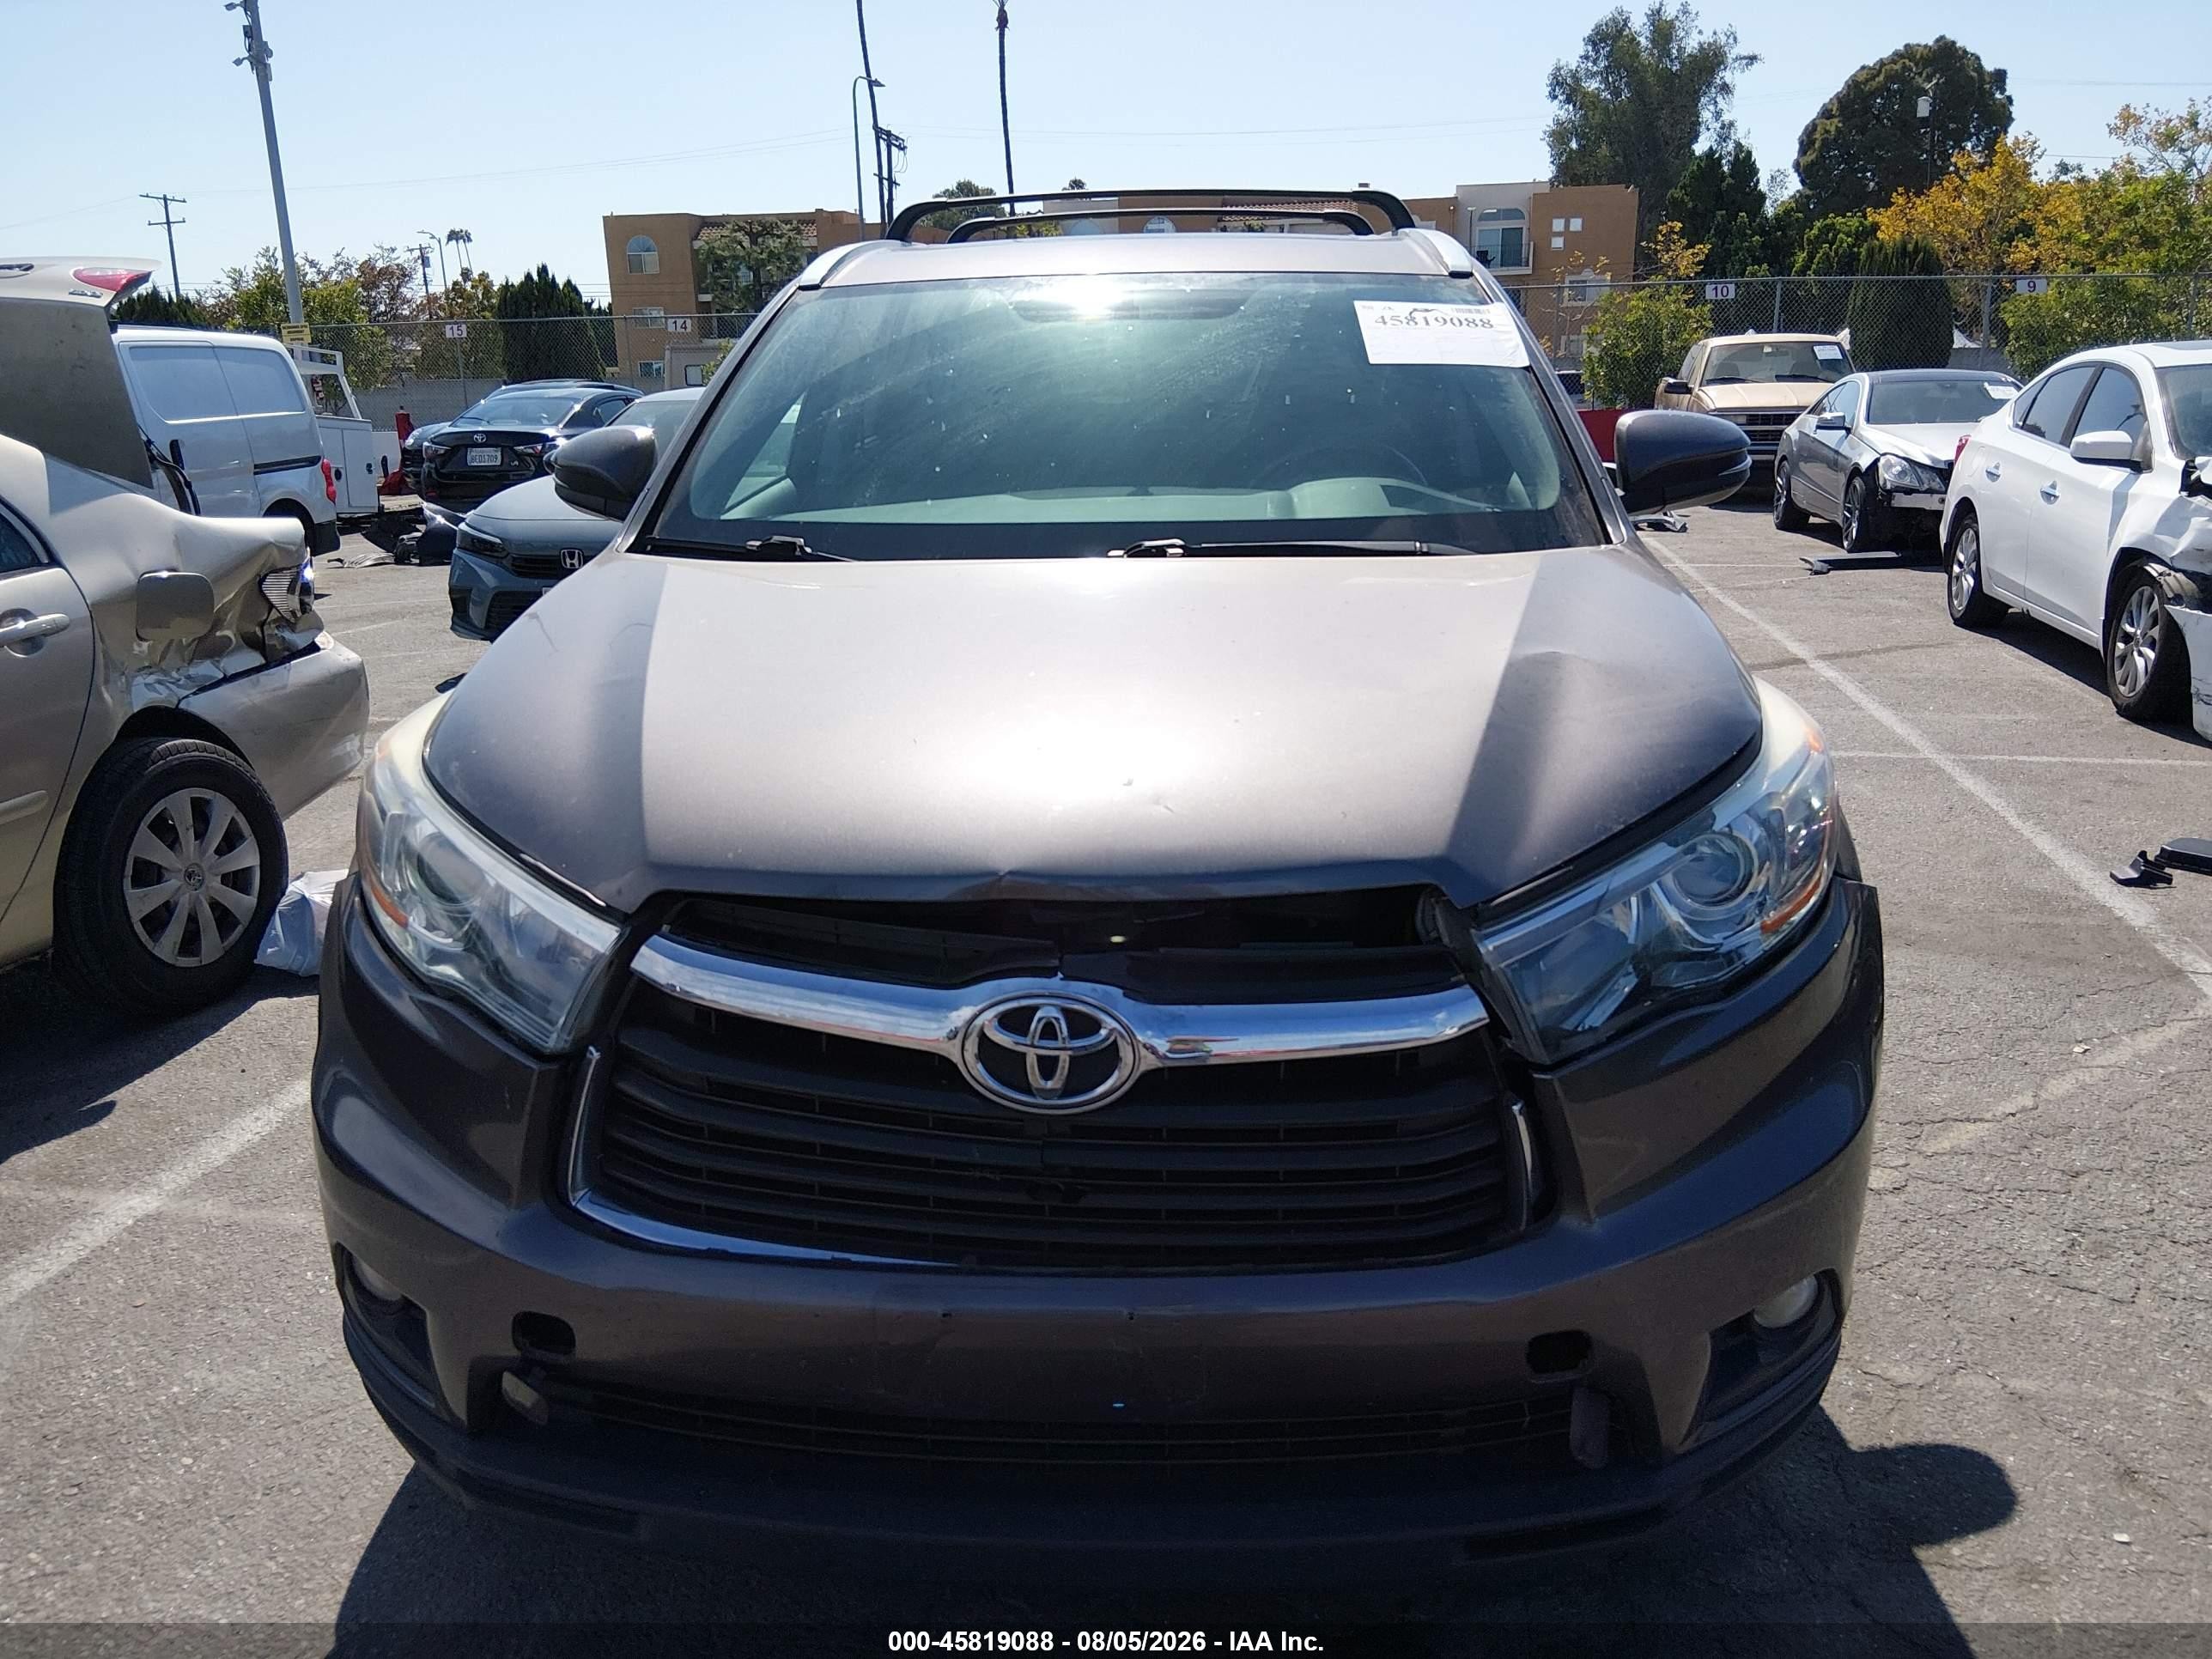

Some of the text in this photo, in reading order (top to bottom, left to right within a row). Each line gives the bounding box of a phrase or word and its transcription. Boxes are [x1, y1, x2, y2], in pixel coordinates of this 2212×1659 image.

[1711, 285, 1729, 298] 10
[2027, 280, 2036, 293] 9
[672, 319, 688, 331] 14
[1375, 314, 1494, 330] 45819088
[449, 324, 464, 337] 15
